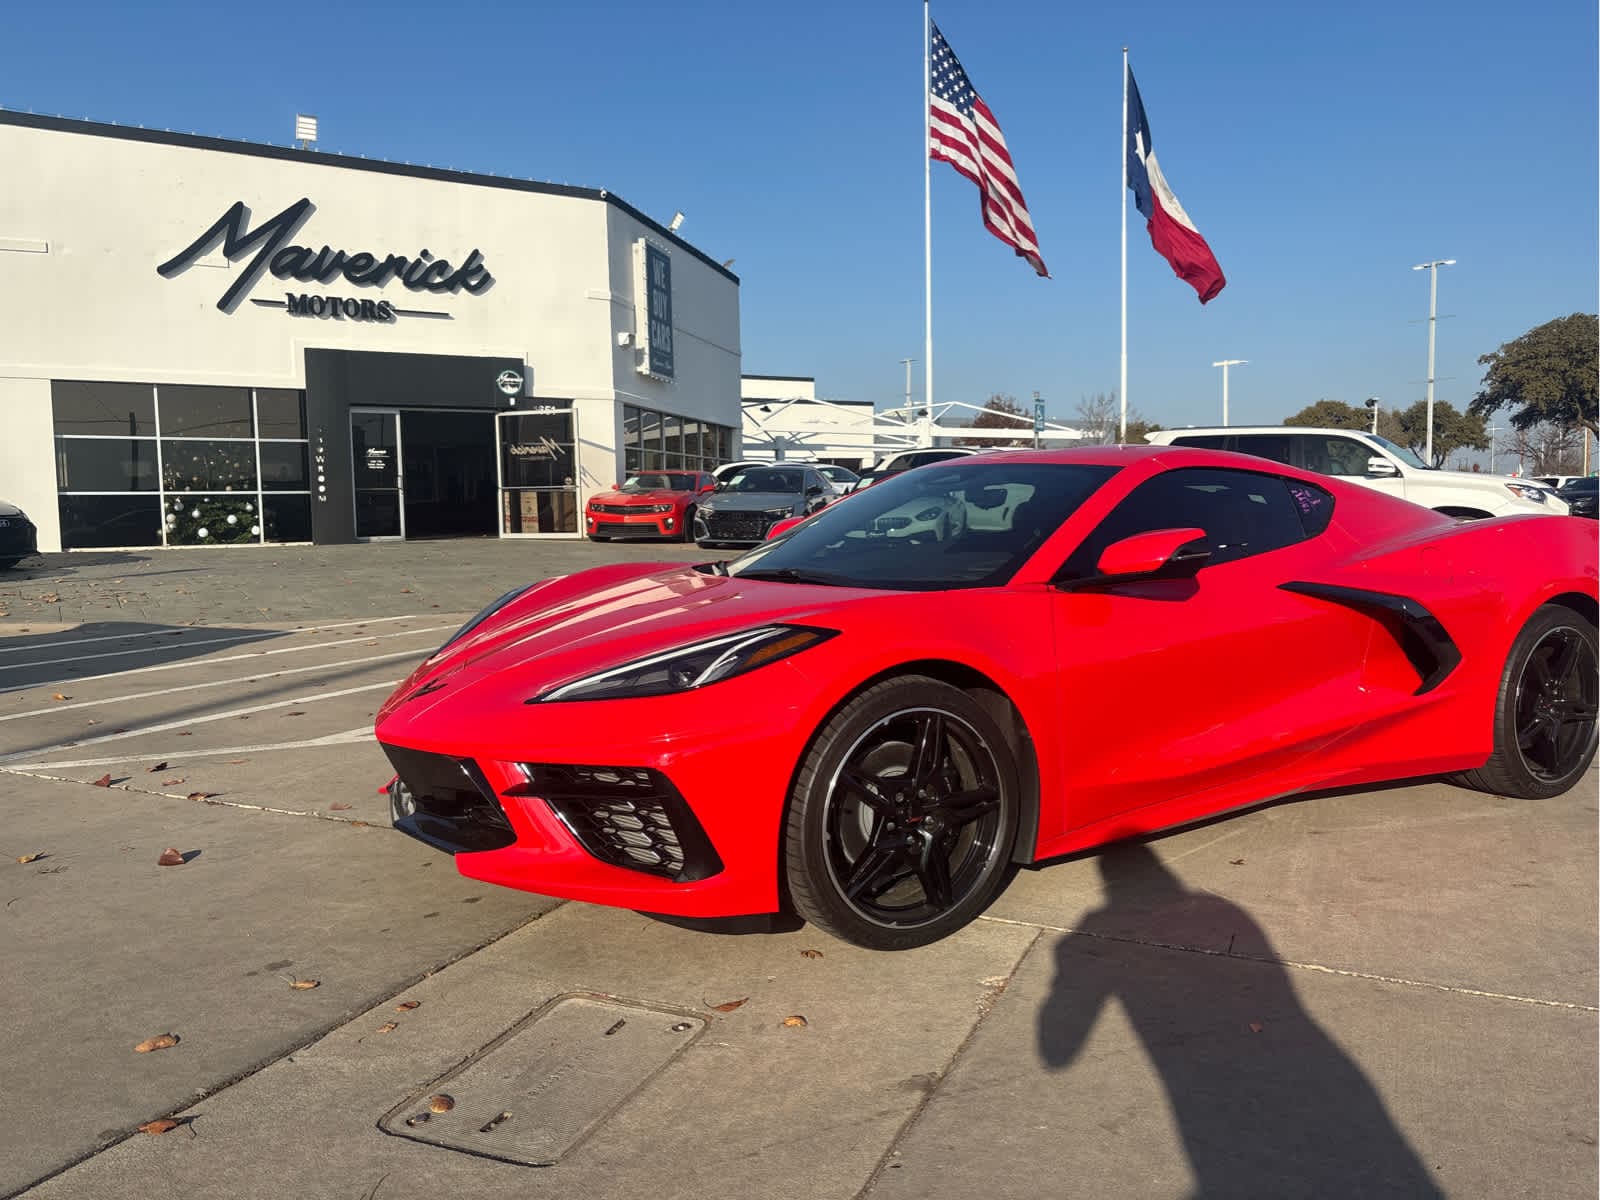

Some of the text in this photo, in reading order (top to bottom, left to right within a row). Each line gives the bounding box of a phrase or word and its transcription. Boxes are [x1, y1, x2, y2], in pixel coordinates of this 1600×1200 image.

[156, 197, 495, 312] Maverick
[652, 255, 666, 289] WE
[285, 293, 394, 322] MOTORS
[652, 288, 668, 320] BUY
[651, 319, 671, 352] CARS
